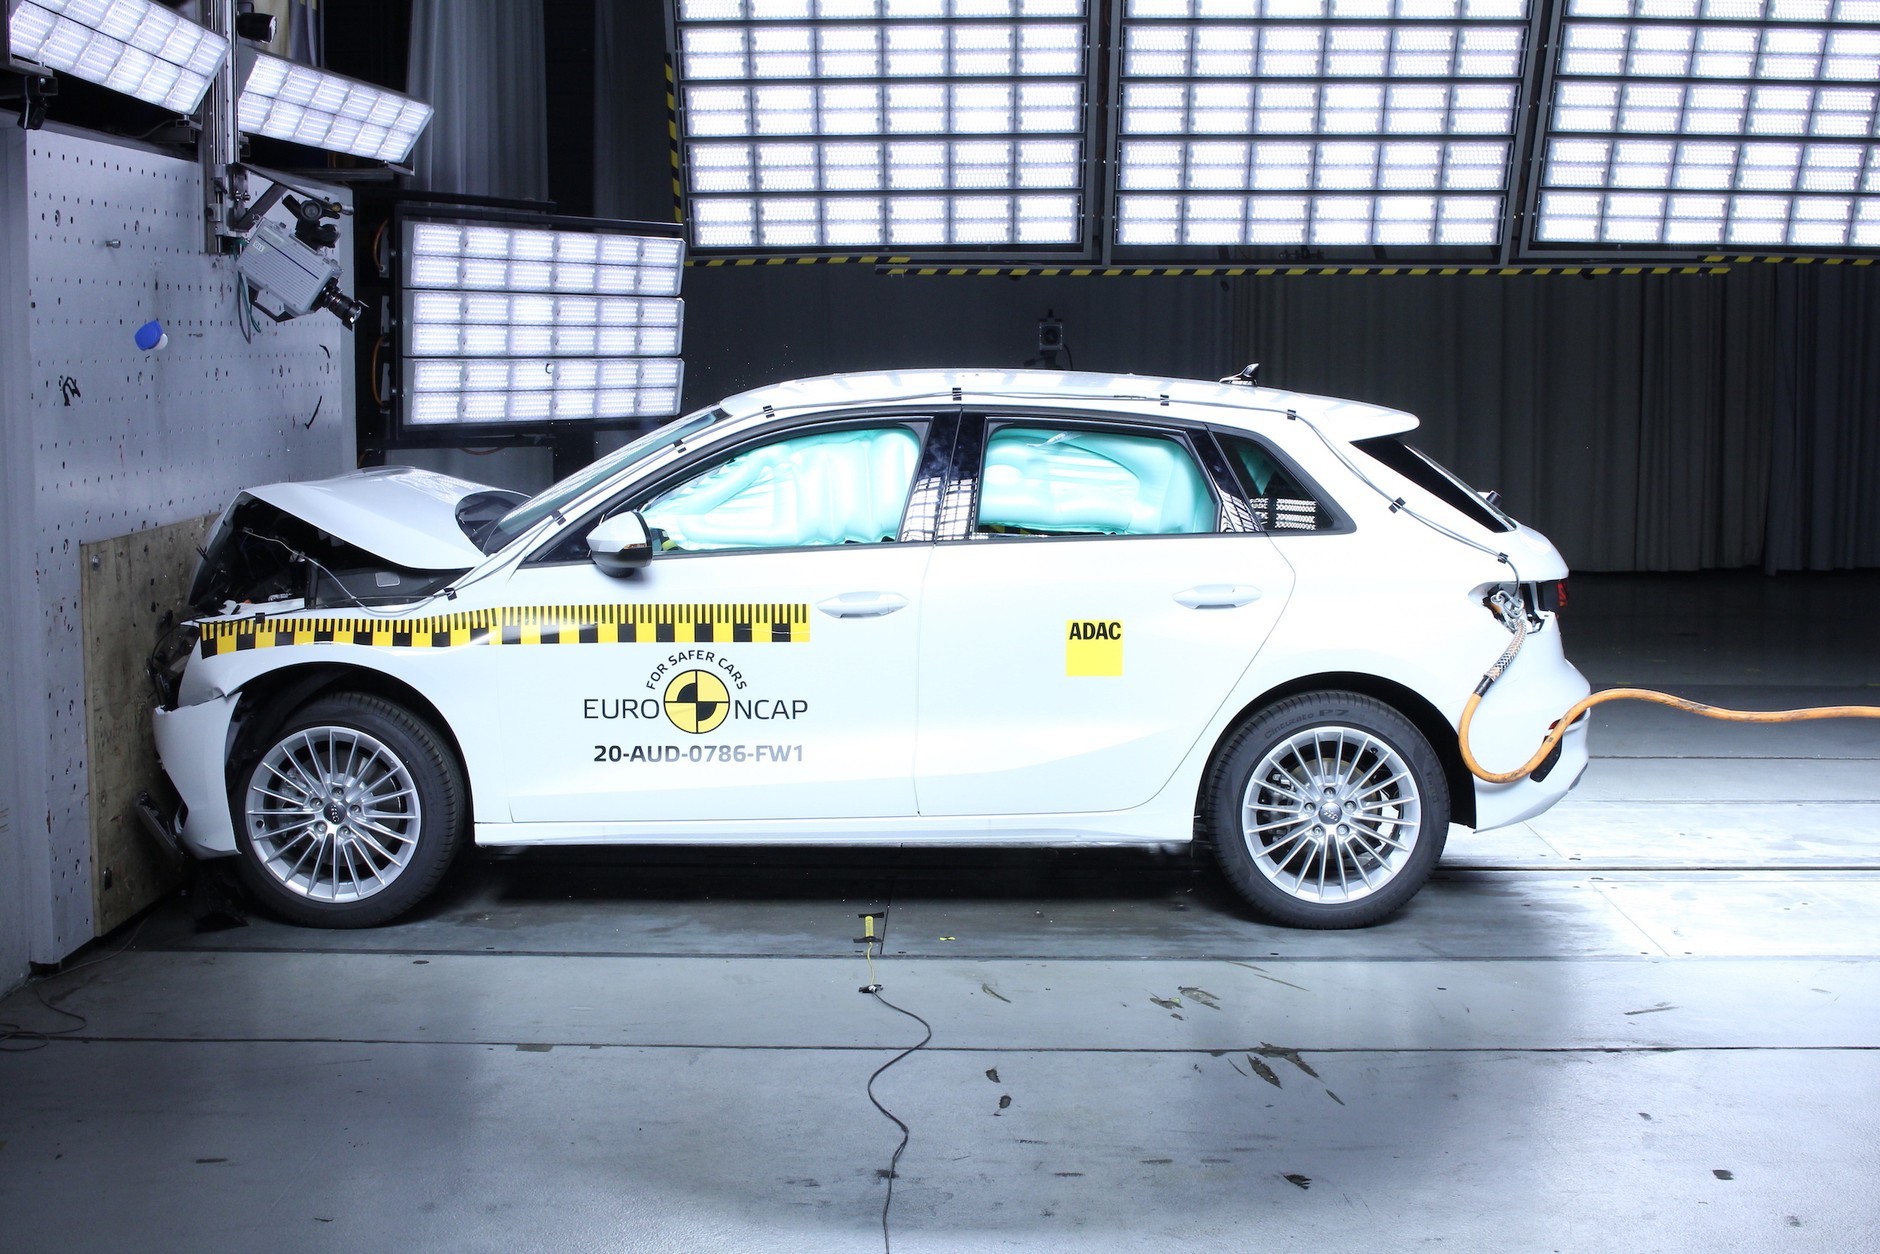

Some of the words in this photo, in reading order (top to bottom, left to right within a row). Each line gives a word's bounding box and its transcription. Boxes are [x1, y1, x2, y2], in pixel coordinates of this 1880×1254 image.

[1069, 622, 1121, 640] ADAC
[646, 662, 668, 690] FOR
[668, 650, 715, 666] SAFER
[718, 658, 748, 690] CARS
[584, 698, 660, 719] EURO
[735, 699, 808, 720] NCAP
[1318, 709, 1350, 717] P7
[594, 745, 803, 763] 20-AUD-0786-FW1
